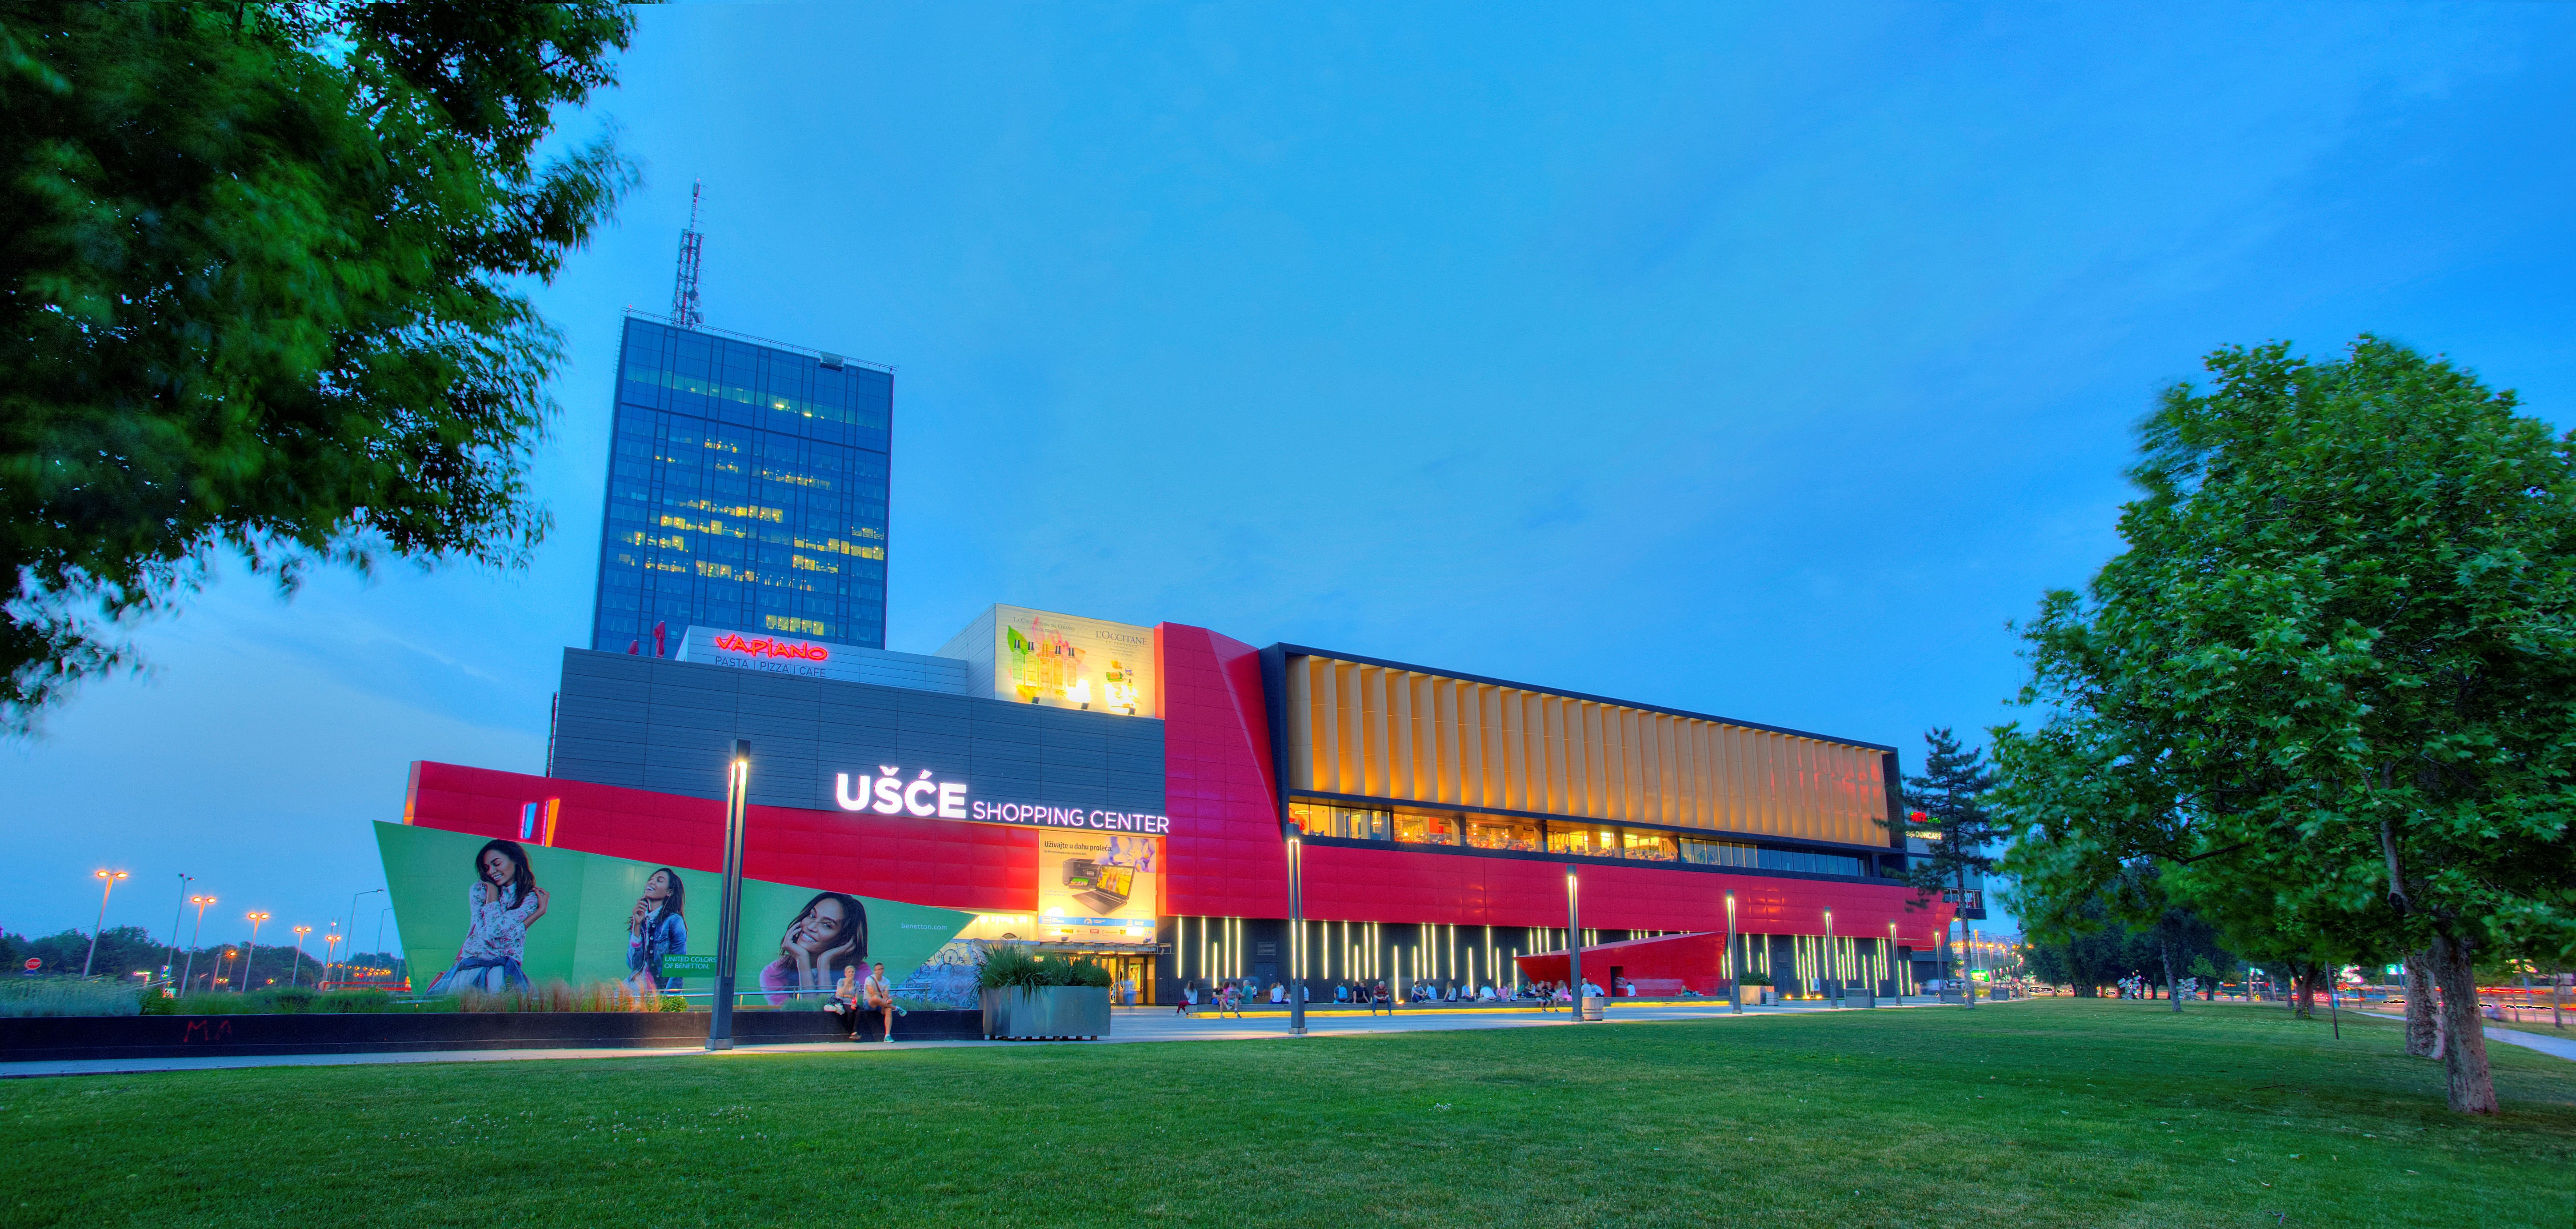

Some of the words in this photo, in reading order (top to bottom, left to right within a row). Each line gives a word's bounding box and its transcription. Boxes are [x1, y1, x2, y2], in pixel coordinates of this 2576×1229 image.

[716, 633, 828, 661] VAPIANO
[1096, 631, 1147, 645] L'OCCITANE
[716, 656, 749, 669] PASTA
[760, 661, 790, 674] PIZZA
[800, 666, 826, 678] CAFE
[836, 765, 967, 819] UŠĆE
[972, 800, 1084, 827] SHOPPING
[1089, 809, 1170, 834] CENTER
[1044, 841, 1068, 849] Uživajte
[901, 922, 947, 930] benetton.com
